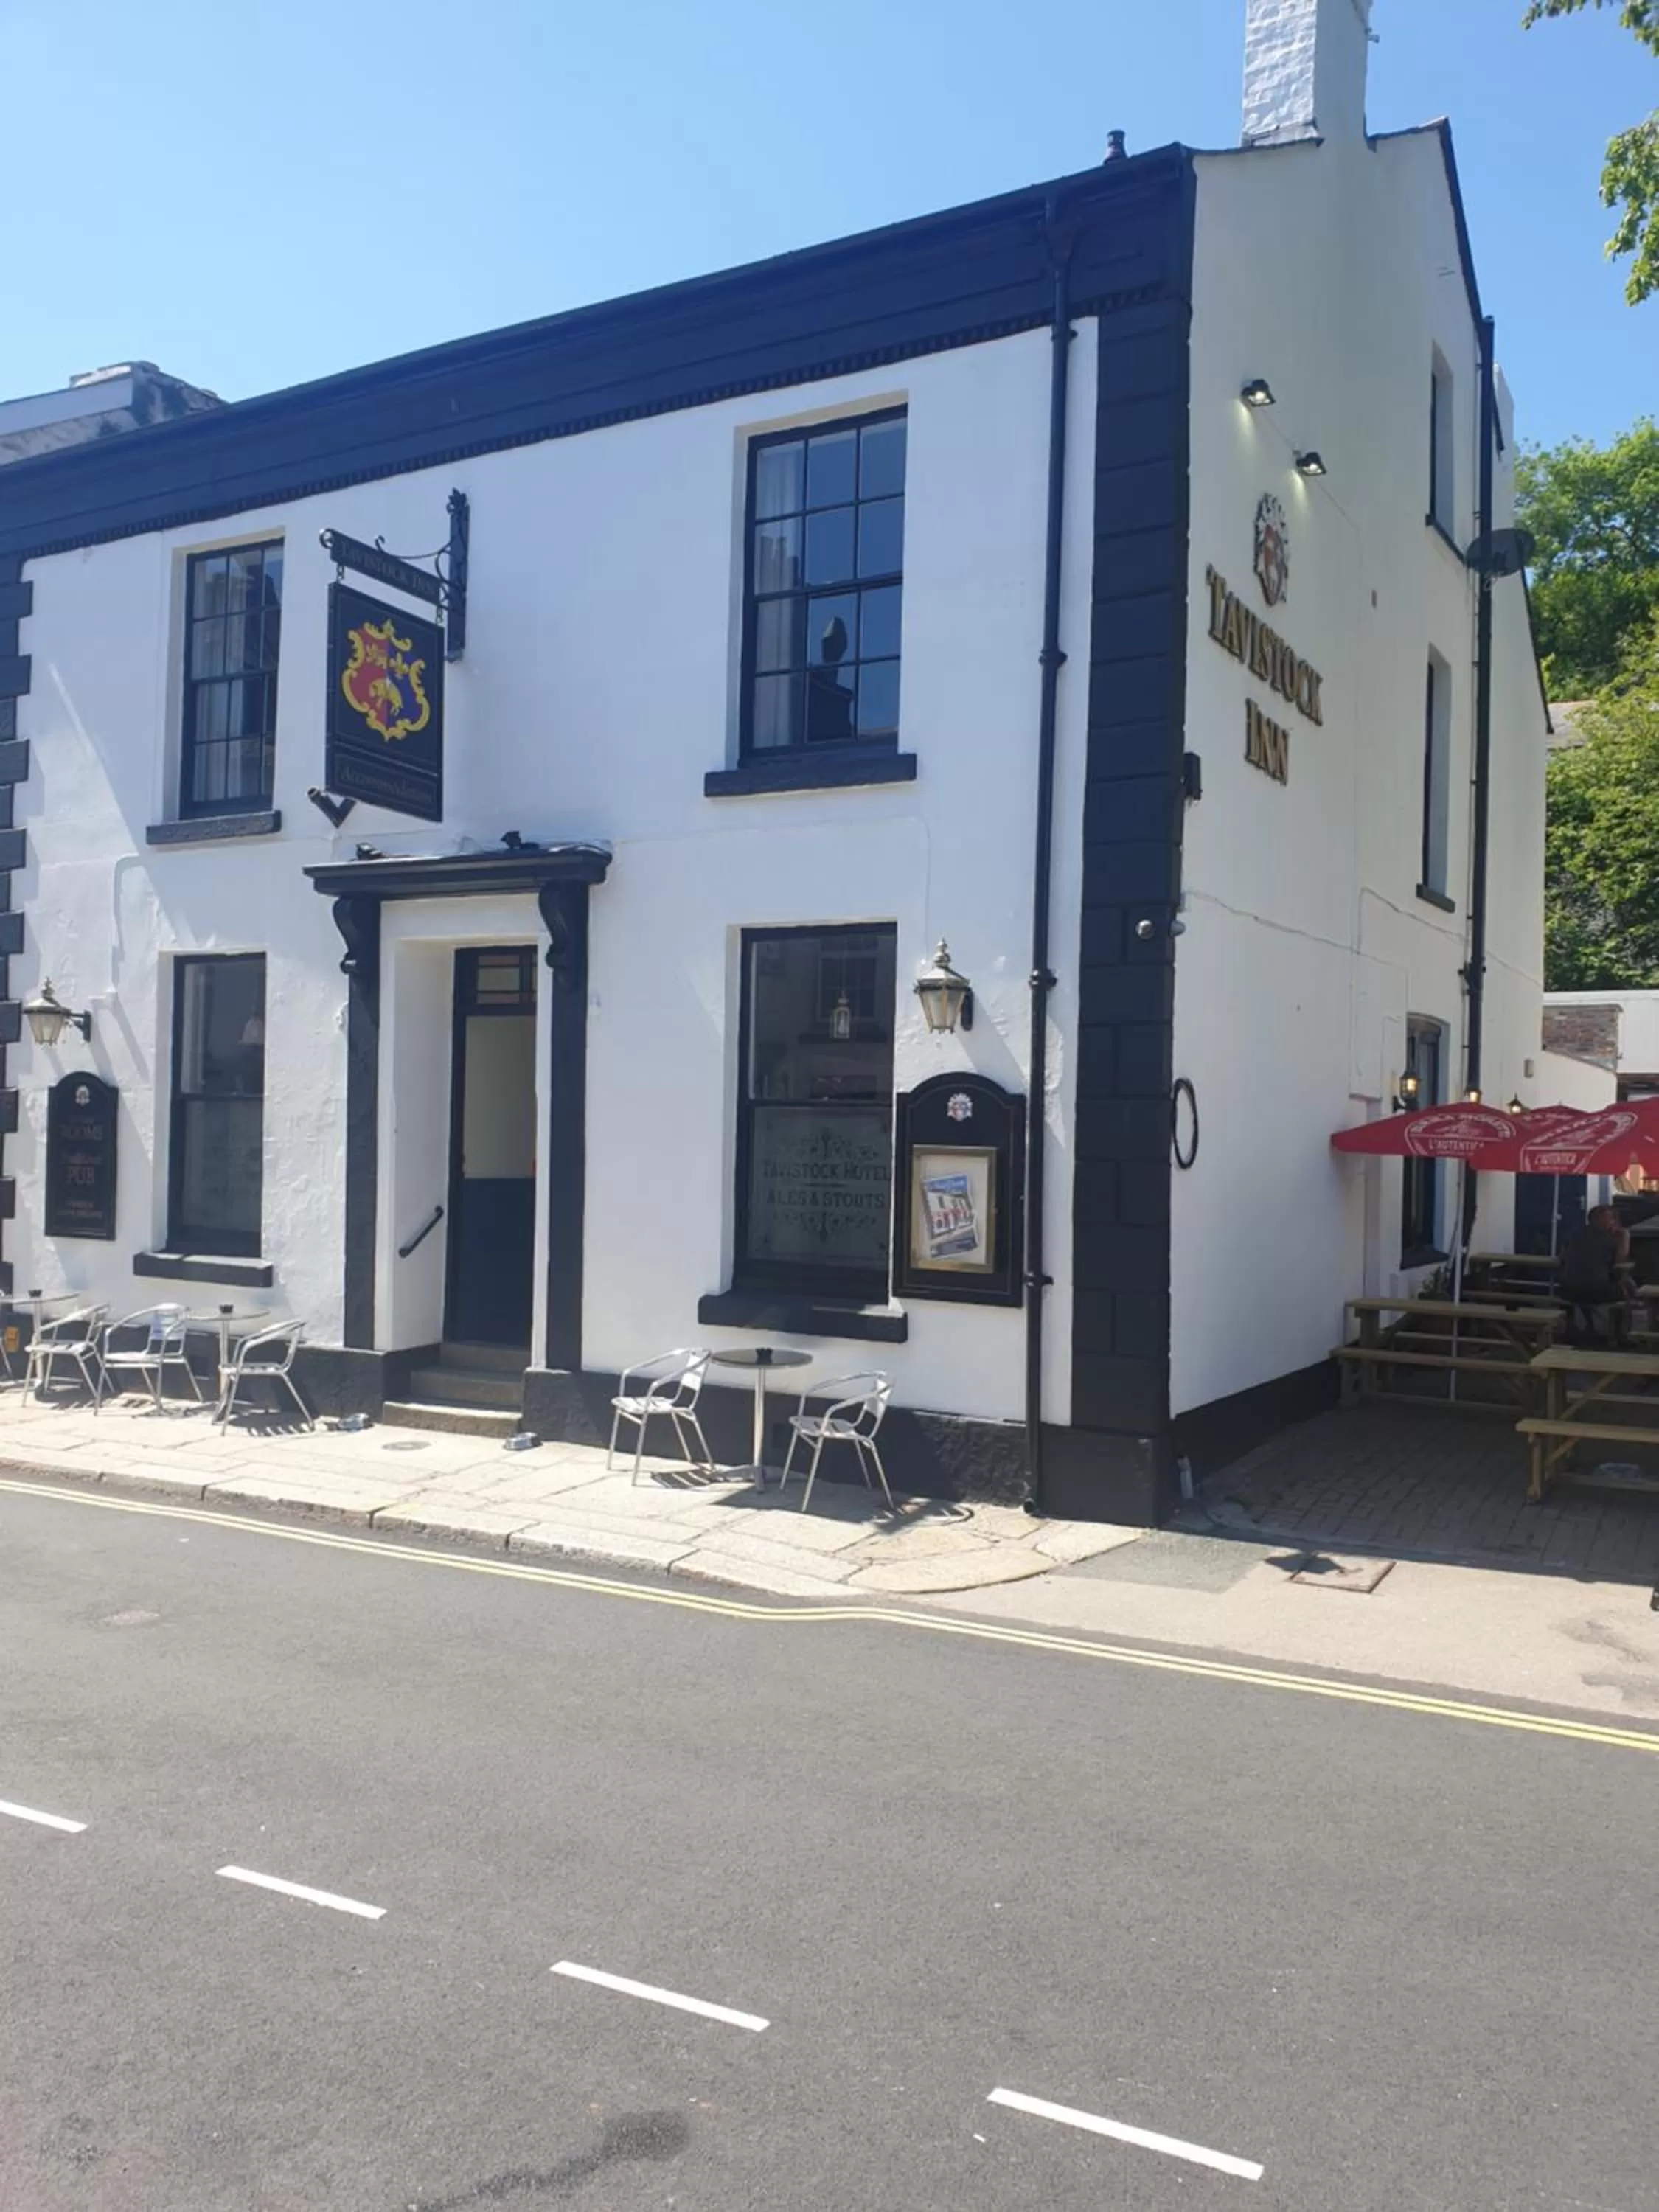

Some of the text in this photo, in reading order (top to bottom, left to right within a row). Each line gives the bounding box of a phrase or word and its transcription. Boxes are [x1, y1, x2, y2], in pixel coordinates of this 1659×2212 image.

[1206, 563, 1324, 727] TAVISTOCK
[1245, 697, 1289, 787] INN
[763, 1160, 890, 1181] TAVISTOCK HOTEL
[767, 1189, 807, 1206] ALES
[822, 1190, 886, 1210] STOUTS
